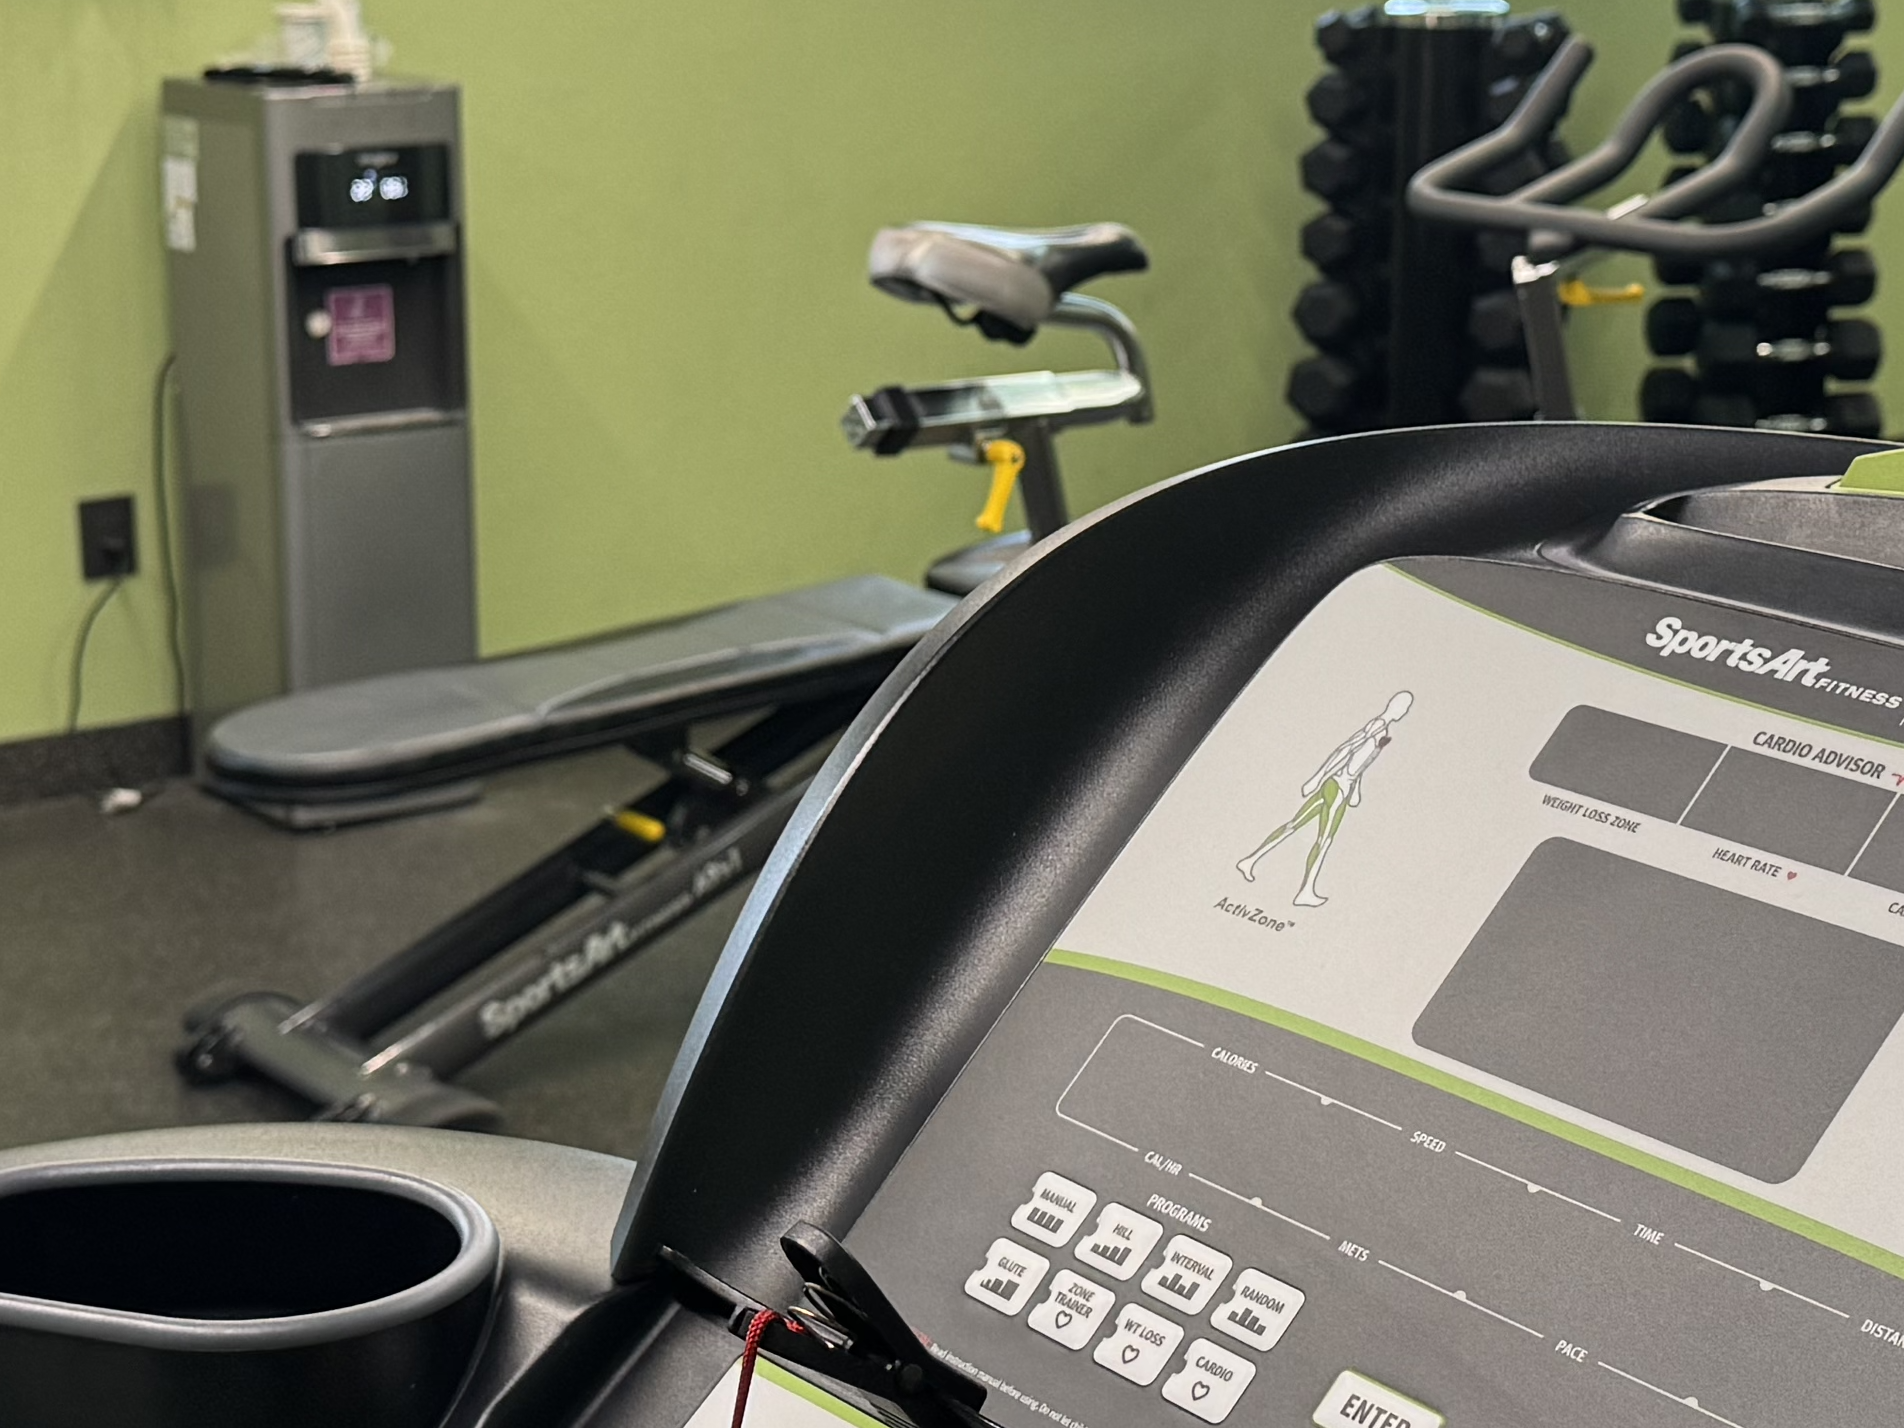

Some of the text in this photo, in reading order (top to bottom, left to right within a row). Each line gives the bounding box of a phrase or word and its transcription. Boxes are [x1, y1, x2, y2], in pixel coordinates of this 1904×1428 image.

[1645, 616, 1829, 687] SportsArt
[1814, 677, 1902, 708] FITNESS
[1752, 731, 1886, 779] CARDIO ADVISOR
[1541, 794, 1641, 833] WEIGHT LOSS ZONE
[1711, 847, 1782, 877] HEART RATE
[1210, 1046, 1259, 1074] CALORIES
[1409, 1130, 1446, 1152] SPEED
[1633, 1223, 1664, 1245] TIME
[1039, 1188, 1076, 1213] MANUAL
[1146, 1193, 1212, 1232] PROGRAMS
[1111, 1223, 1133, 1241] HILL
[997, 1256, 1027, 1278] GLUTE
[1144, 1151, 1182, 1176] CAL/HR
[1337, 1240, 1370, 1261] METS
[1554, 1339, 1588, 1363] PACE
[1169, 1251, 1214, 1281] INTERVAL
[1054, 1291, 1093, 1319] TRAINER
[1067, 1282, 1095, 1302] ZONE
[1239, 1285, 1285, 1314] RANDOM
[1123, 1318, 1166, 1347] WT LOSS
[1195, 1355, 1233, 1382] CARDIO
[1048, 1410, 1062, 1421] not
